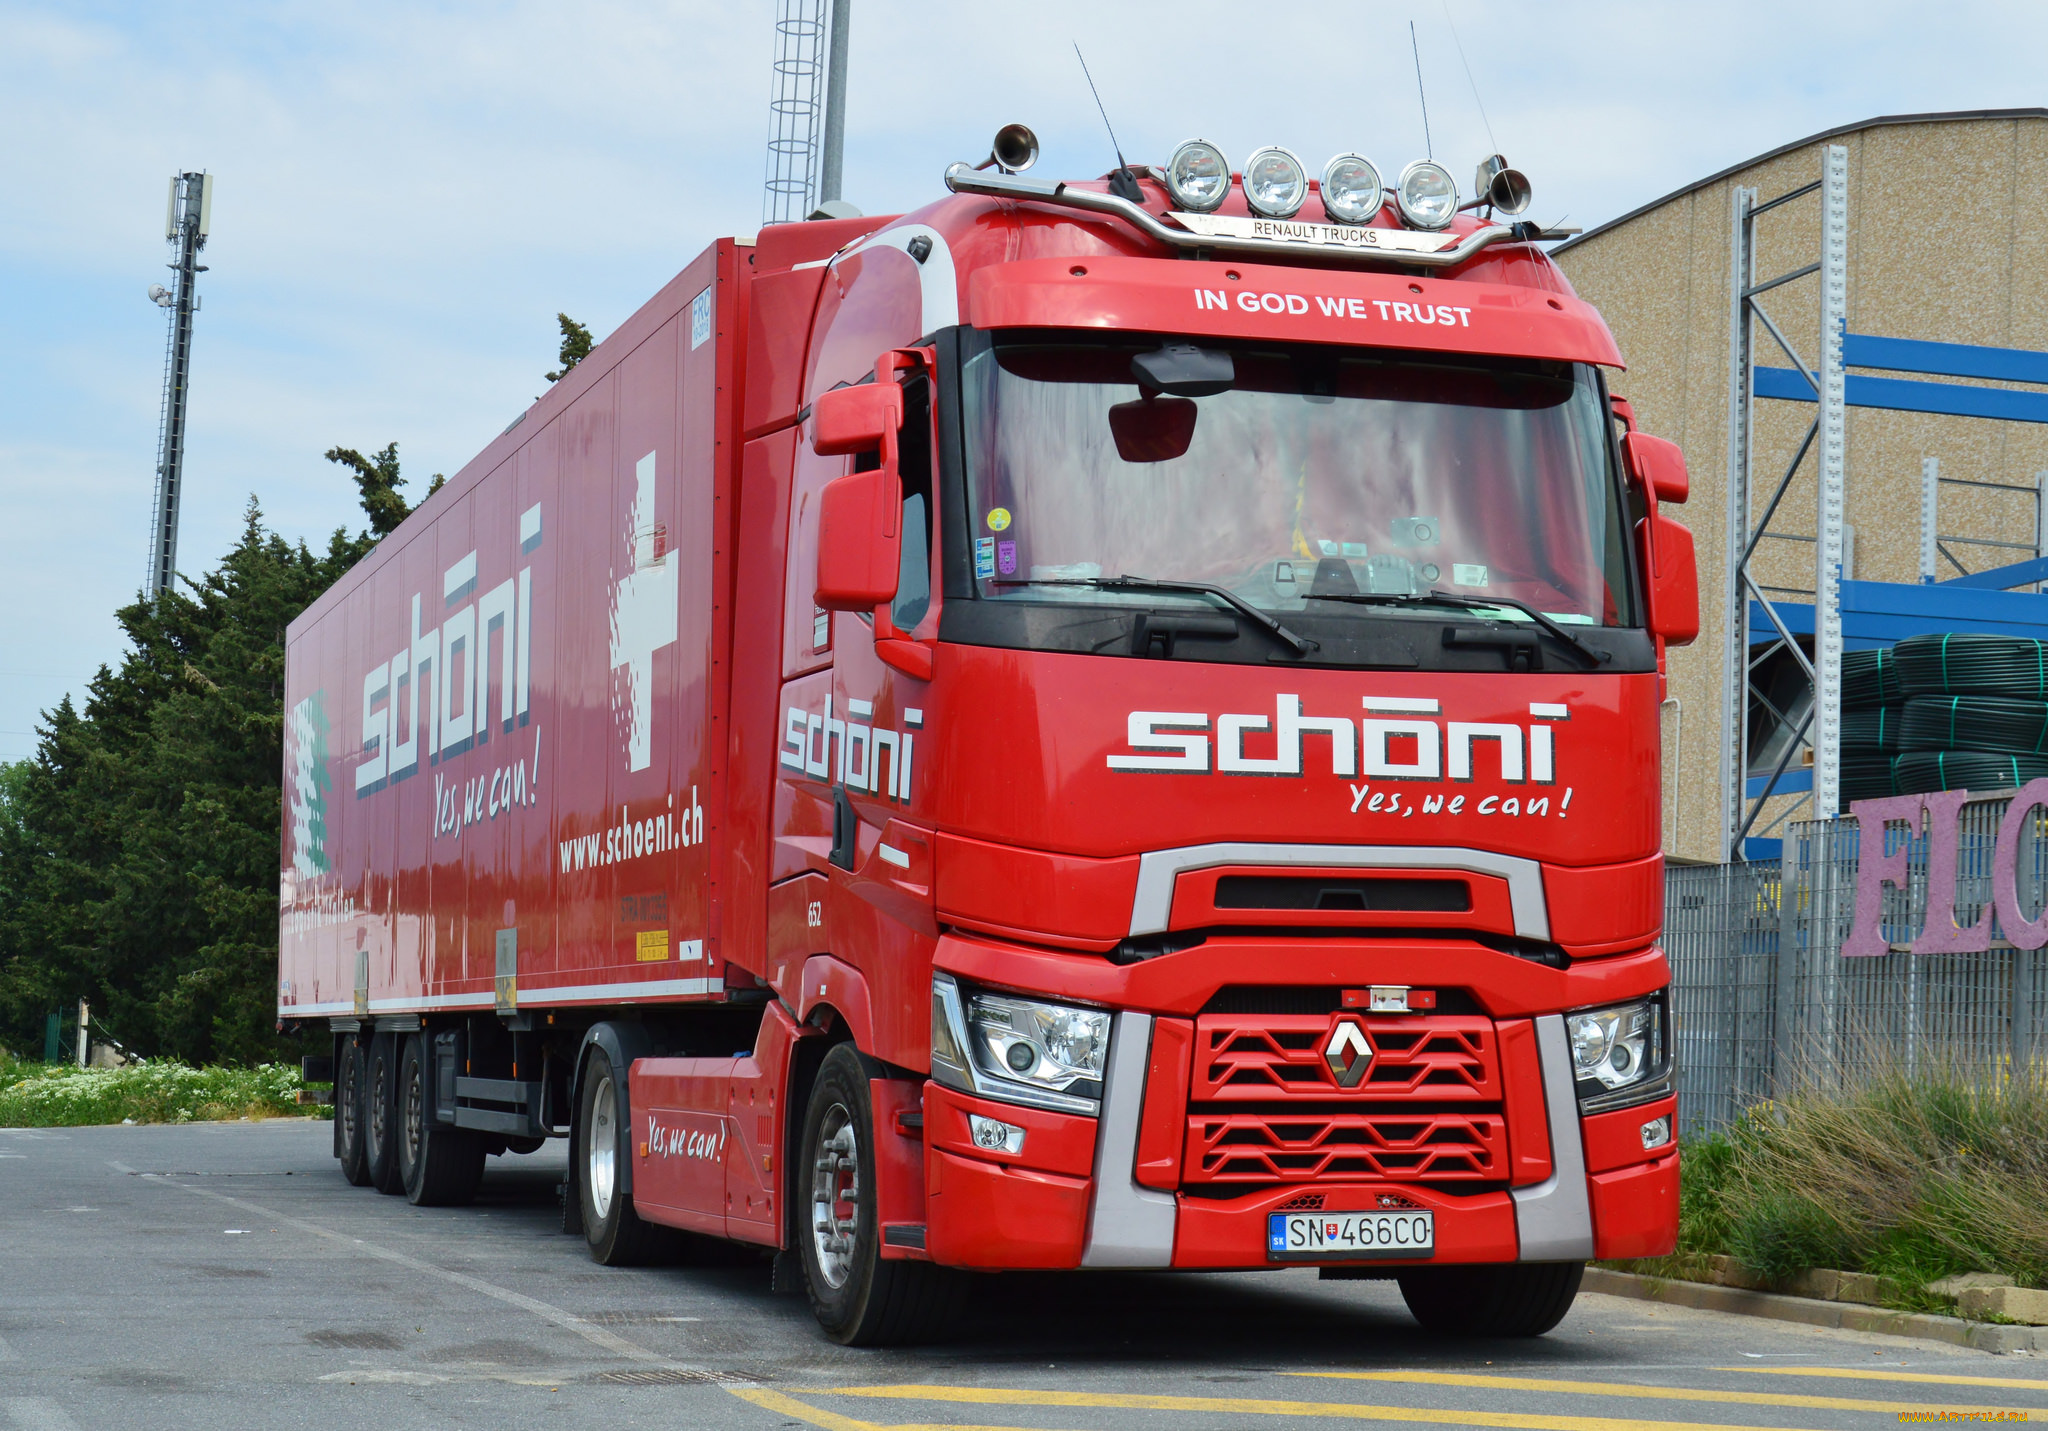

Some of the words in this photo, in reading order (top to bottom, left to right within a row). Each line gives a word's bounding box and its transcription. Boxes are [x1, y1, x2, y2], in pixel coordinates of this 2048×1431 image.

[1254, 221, 1317, 239] RENAULT
[1322, 226, 1377, 243] TRUCKS
[693, 289, 710, 328] FRC
[1194, 289, 1229, 310] IN
[1236, 291, 1309, 315] GOD
[1315, 296, 1367, 319] WE
[1373, 300, 1471, 327] TRUST
[560, 784, 704, 874] www.schoeni.ch
[808, 901, 822, 927] 652
[1273, 1237, 1284, 1246] SK
